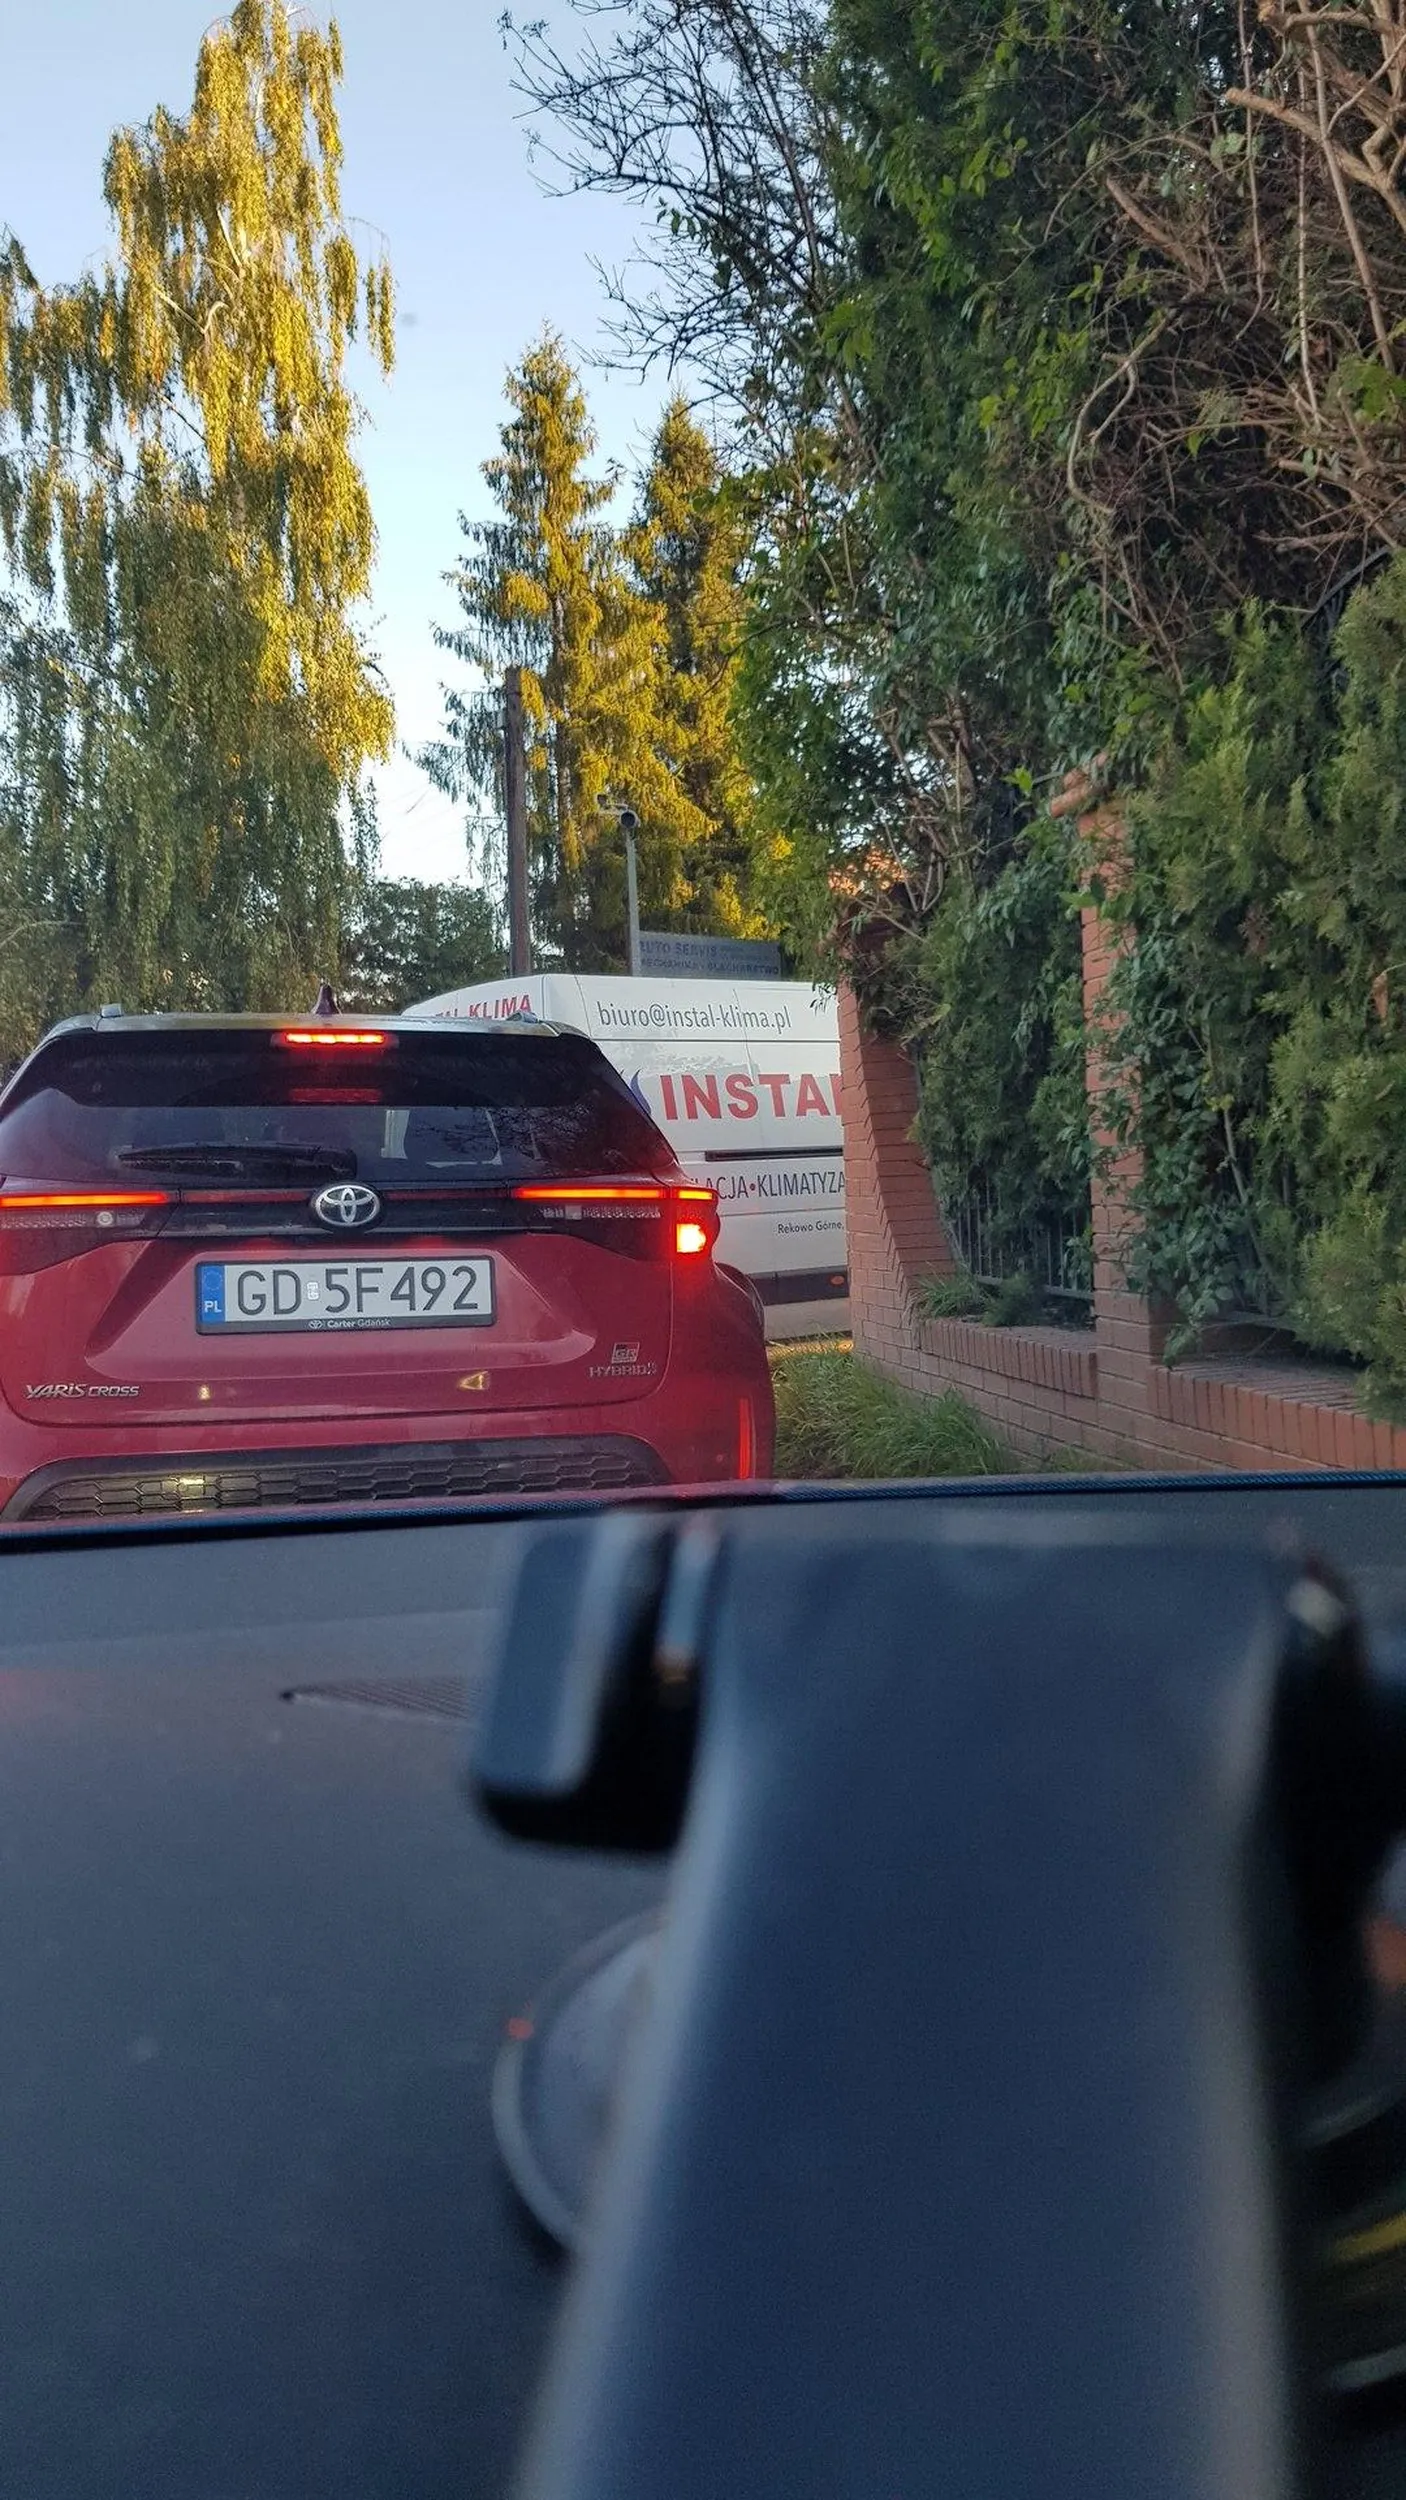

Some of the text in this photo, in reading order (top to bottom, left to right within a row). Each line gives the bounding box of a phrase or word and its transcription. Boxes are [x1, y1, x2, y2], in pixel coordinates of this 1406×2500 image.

[468, 994, 532, 1019] KLIMA
[597, 1001, 792, 1034] biuro@instal-klima.pl
[777, 1222, 814, 1234] Rekowo
[237, 1265, 479, 1316] GD 5F492
[204, 1300, 222, 1314] PL
[327, 1319, 356, 1329] Carter
[589, 1363, 647, 1377] HYBRID
[88, 1385, 140, 1397] CROSS
